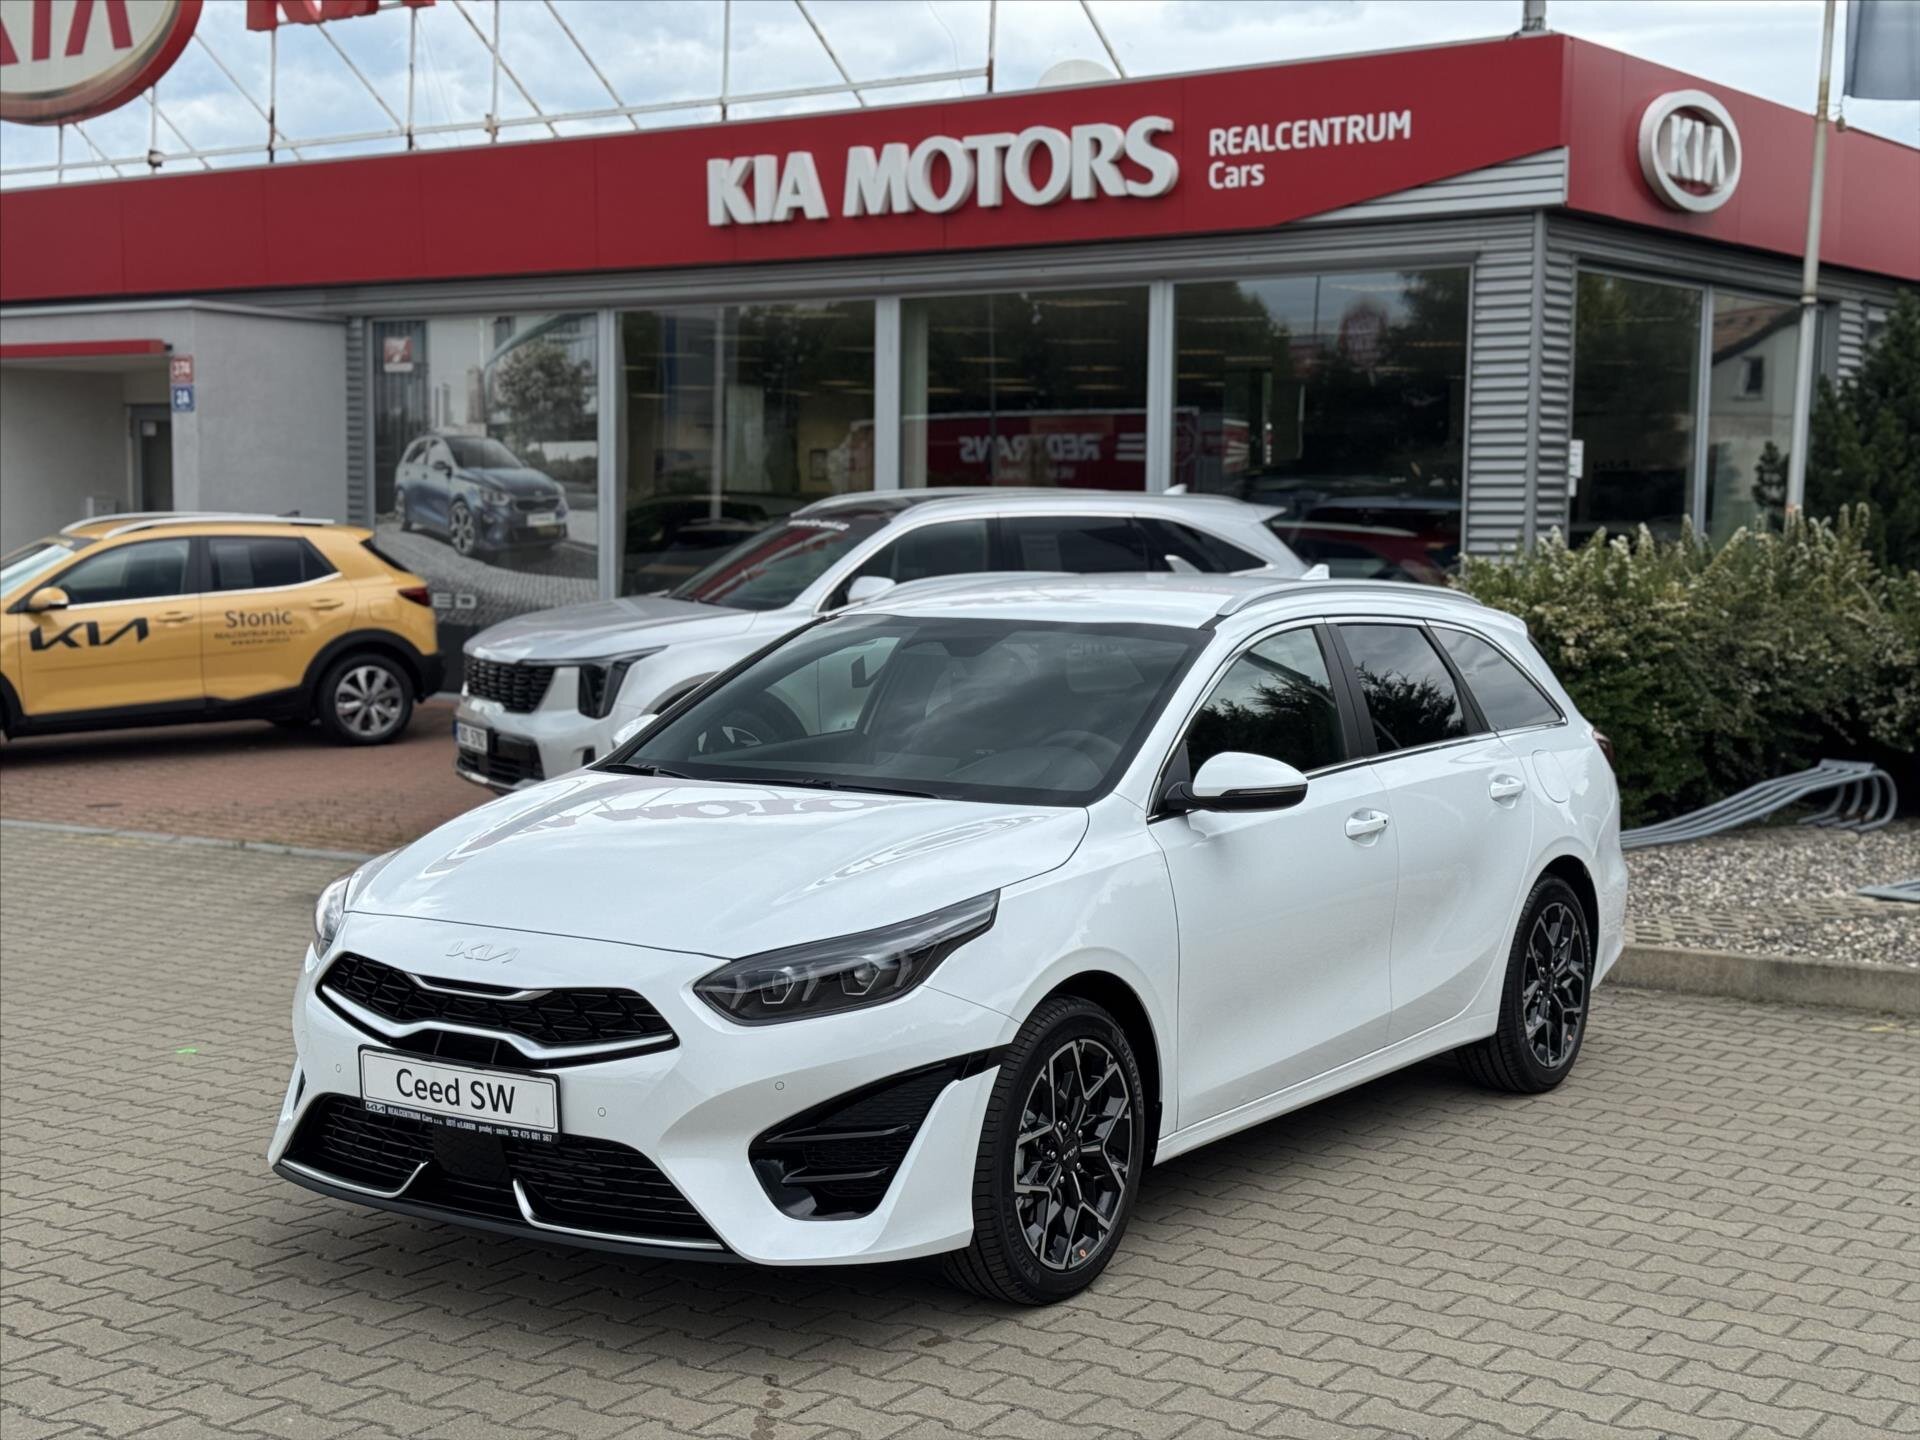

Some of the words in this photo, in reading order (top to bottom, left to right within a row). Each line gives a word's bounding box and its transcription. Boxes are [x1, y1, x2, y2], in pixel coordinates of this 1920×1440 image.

[1209, 109, 1412, 157] REALCENTRUM
[1670, 114, 1726, 185] KIA
[706, 150, 830, 227] KIA
[843, 115, 1179, 217] MOTORS
[1208, 161, 1265, 190] Cars
[225, 607, 292, 629] Stonic
[432, 592, 477, 609] ED
[29, 617, 149, 652] KIA
[396, 1068, 460, 1106] Ceed
[470, 1080, 515, 1114] SW
[520, 1130, 530, 1140] 475
